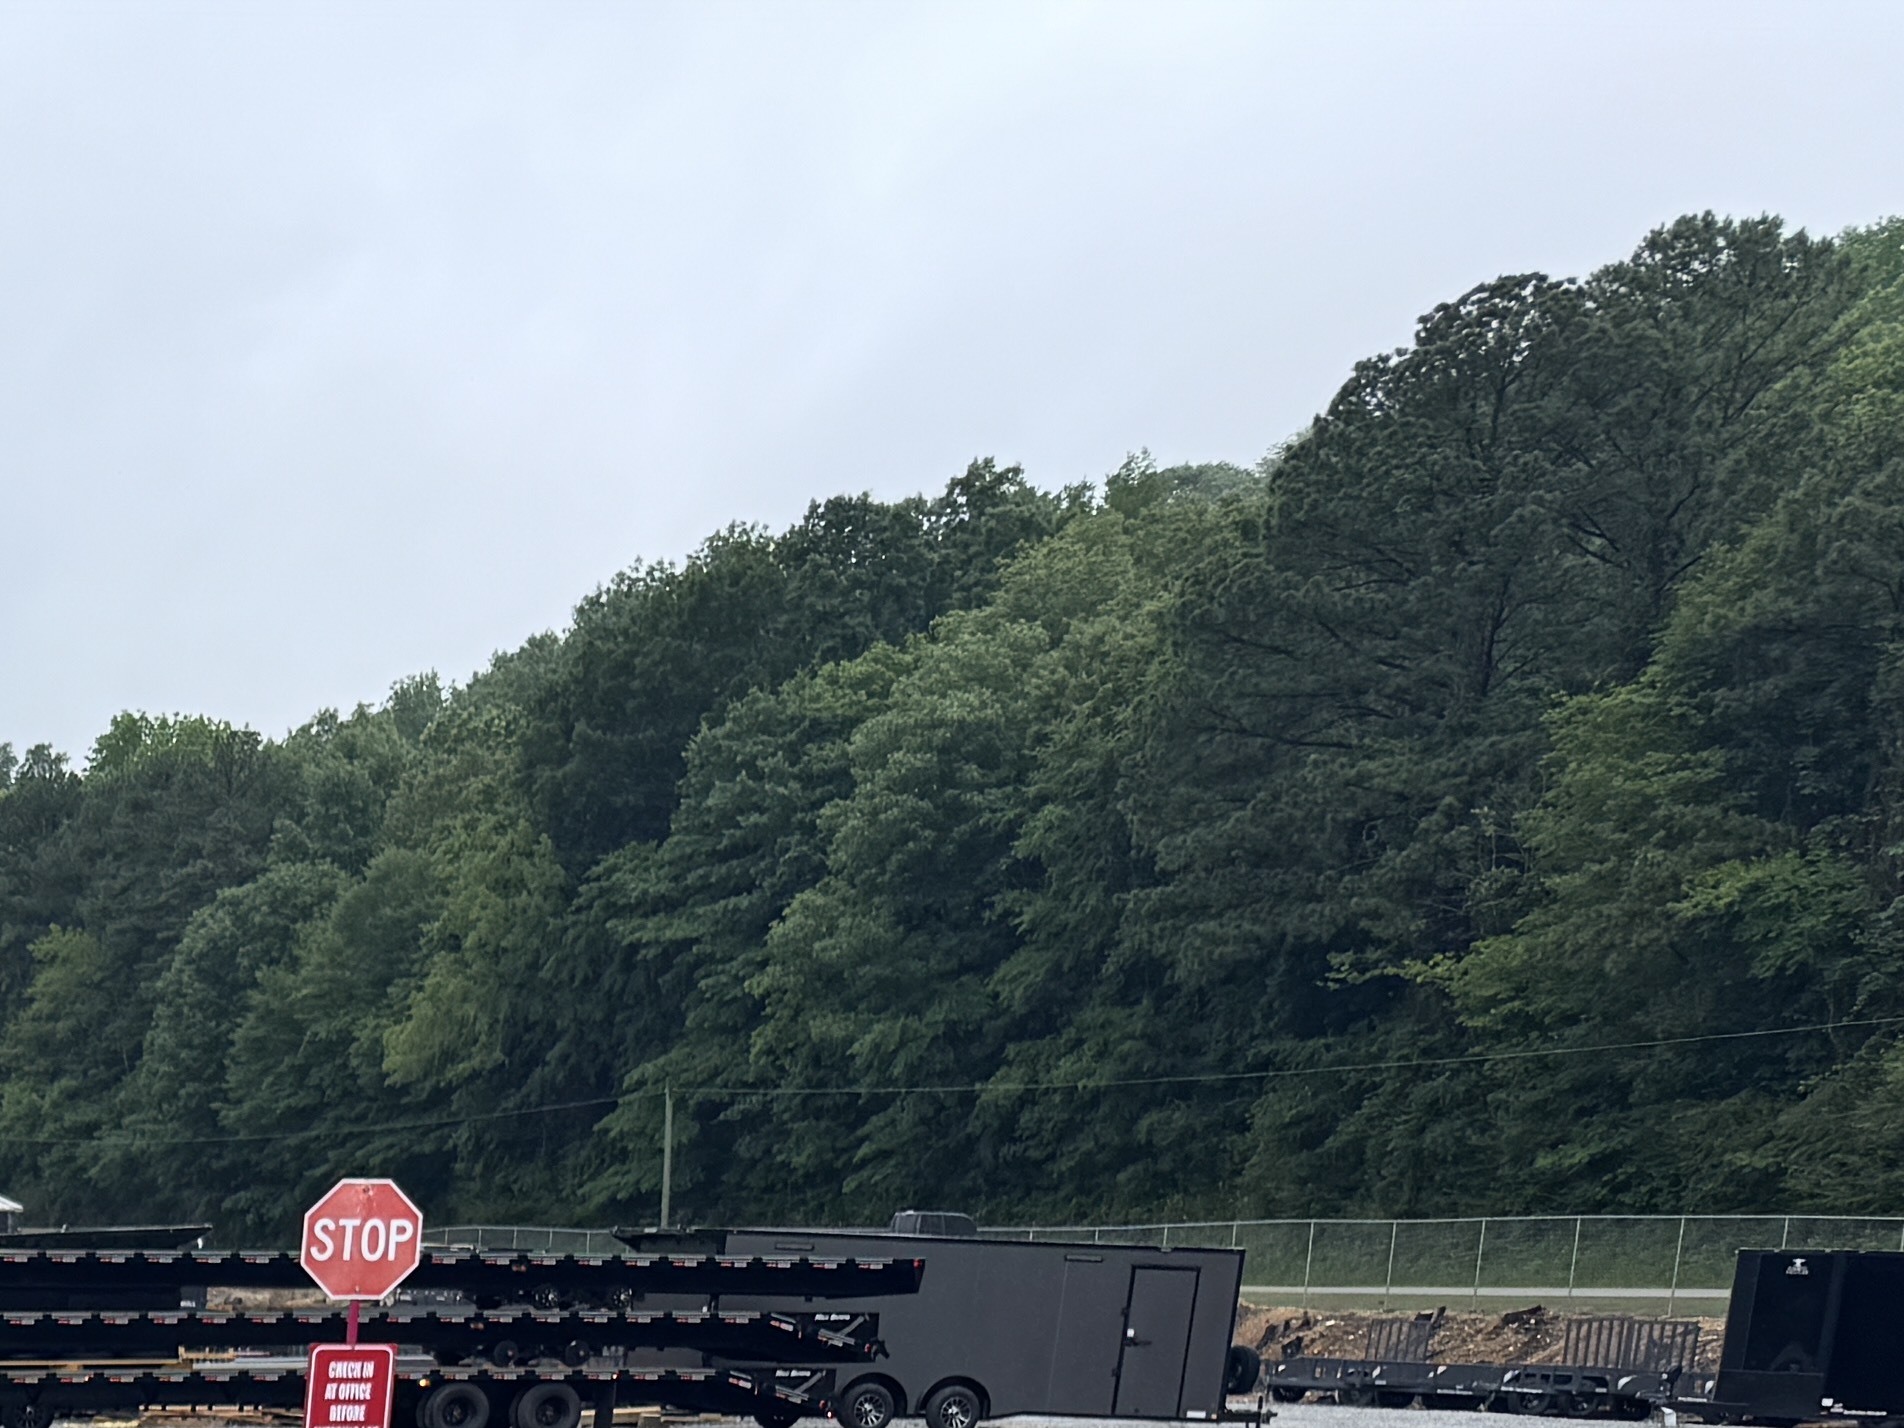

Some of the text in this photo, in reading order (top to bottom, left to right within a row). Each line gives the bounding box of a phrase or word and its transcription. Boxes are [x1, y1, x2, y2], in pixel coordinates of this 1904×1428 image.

[310, 1218, 414, 1262] STOP
[328, 1361, 375, 1379] CHECK IN
[324, 1383, 372, 1400] AT OFFICE
[329, 1404, 366, 1422] BEFORE
